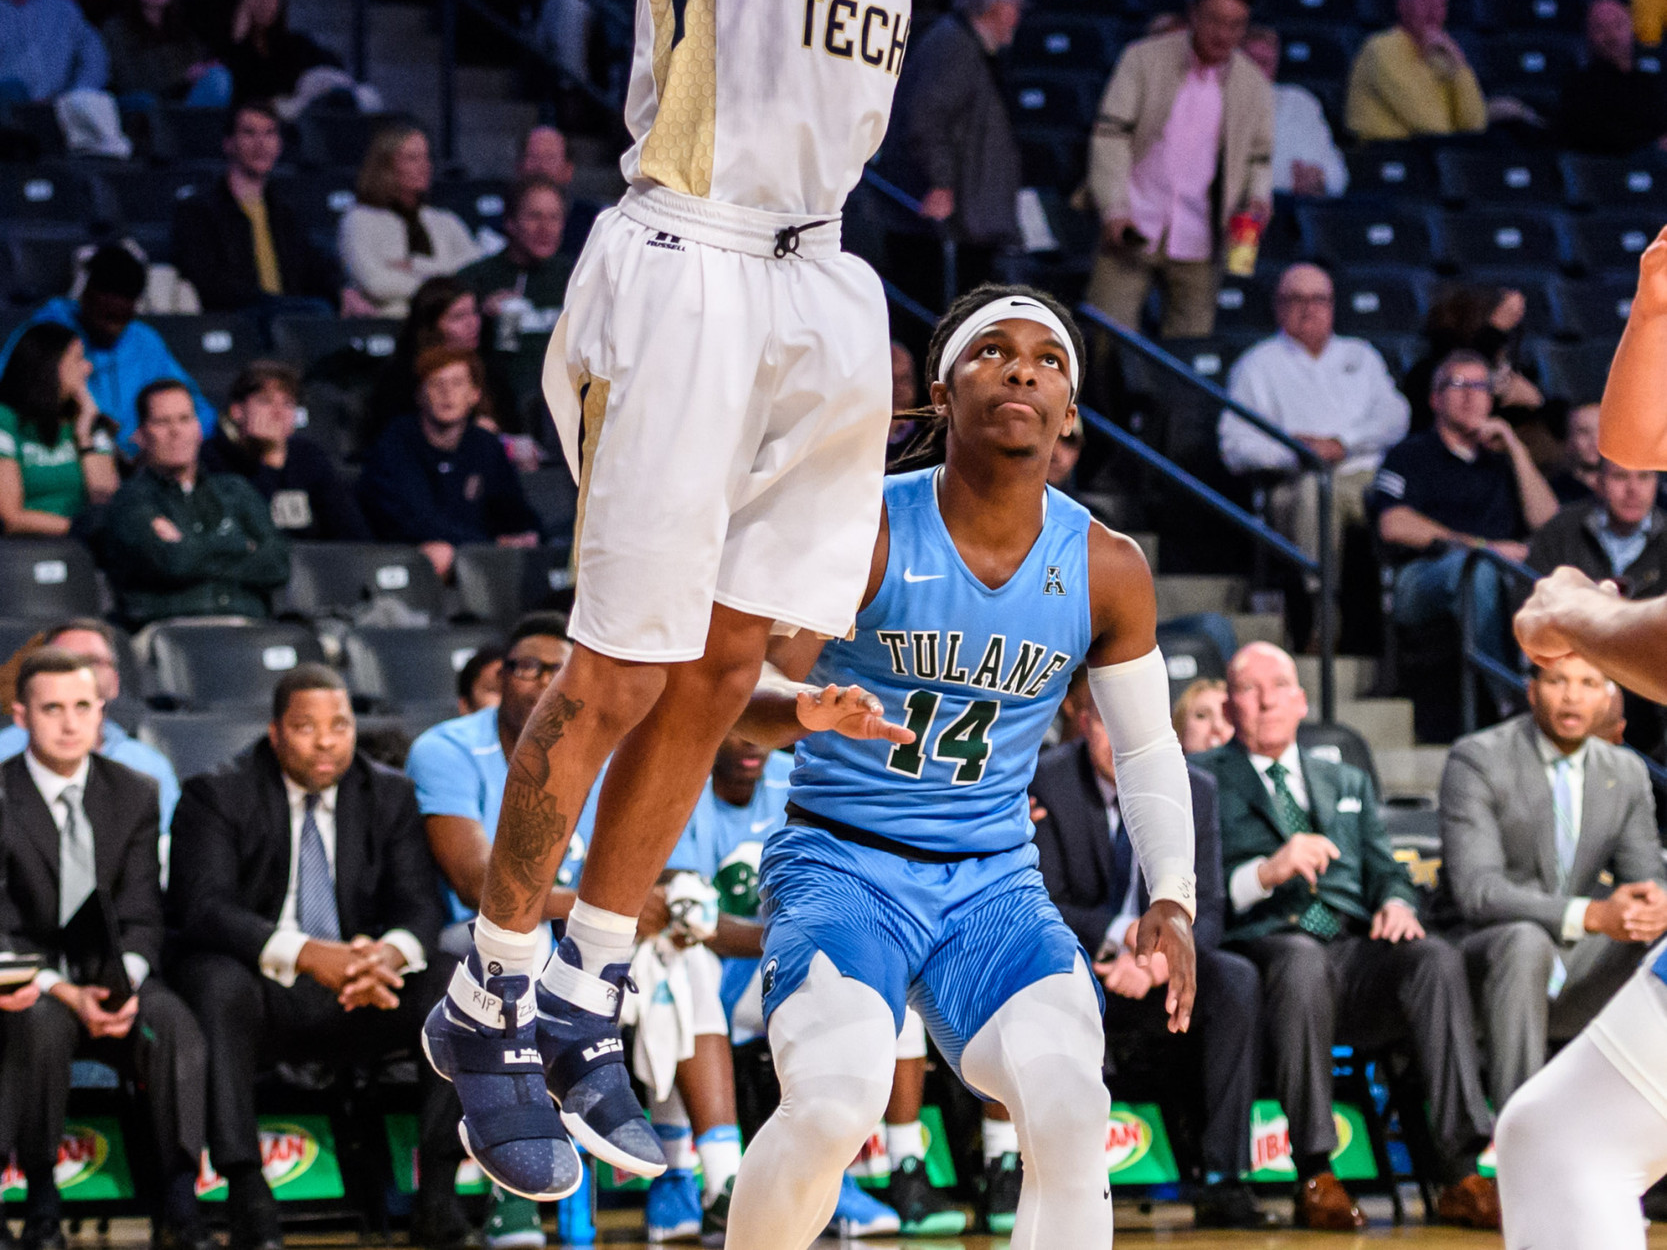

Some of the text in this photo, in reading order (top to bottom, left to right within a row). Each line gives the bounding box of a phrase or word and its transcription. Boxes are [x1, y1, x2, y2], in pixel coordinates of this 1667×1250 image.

[646, 239, 686, 252] RUSSELL
[876, 630, 1071, 699] TULANE
[886, 689, 1001, 786] 14
[472, 990, 497, 1010] RIP
